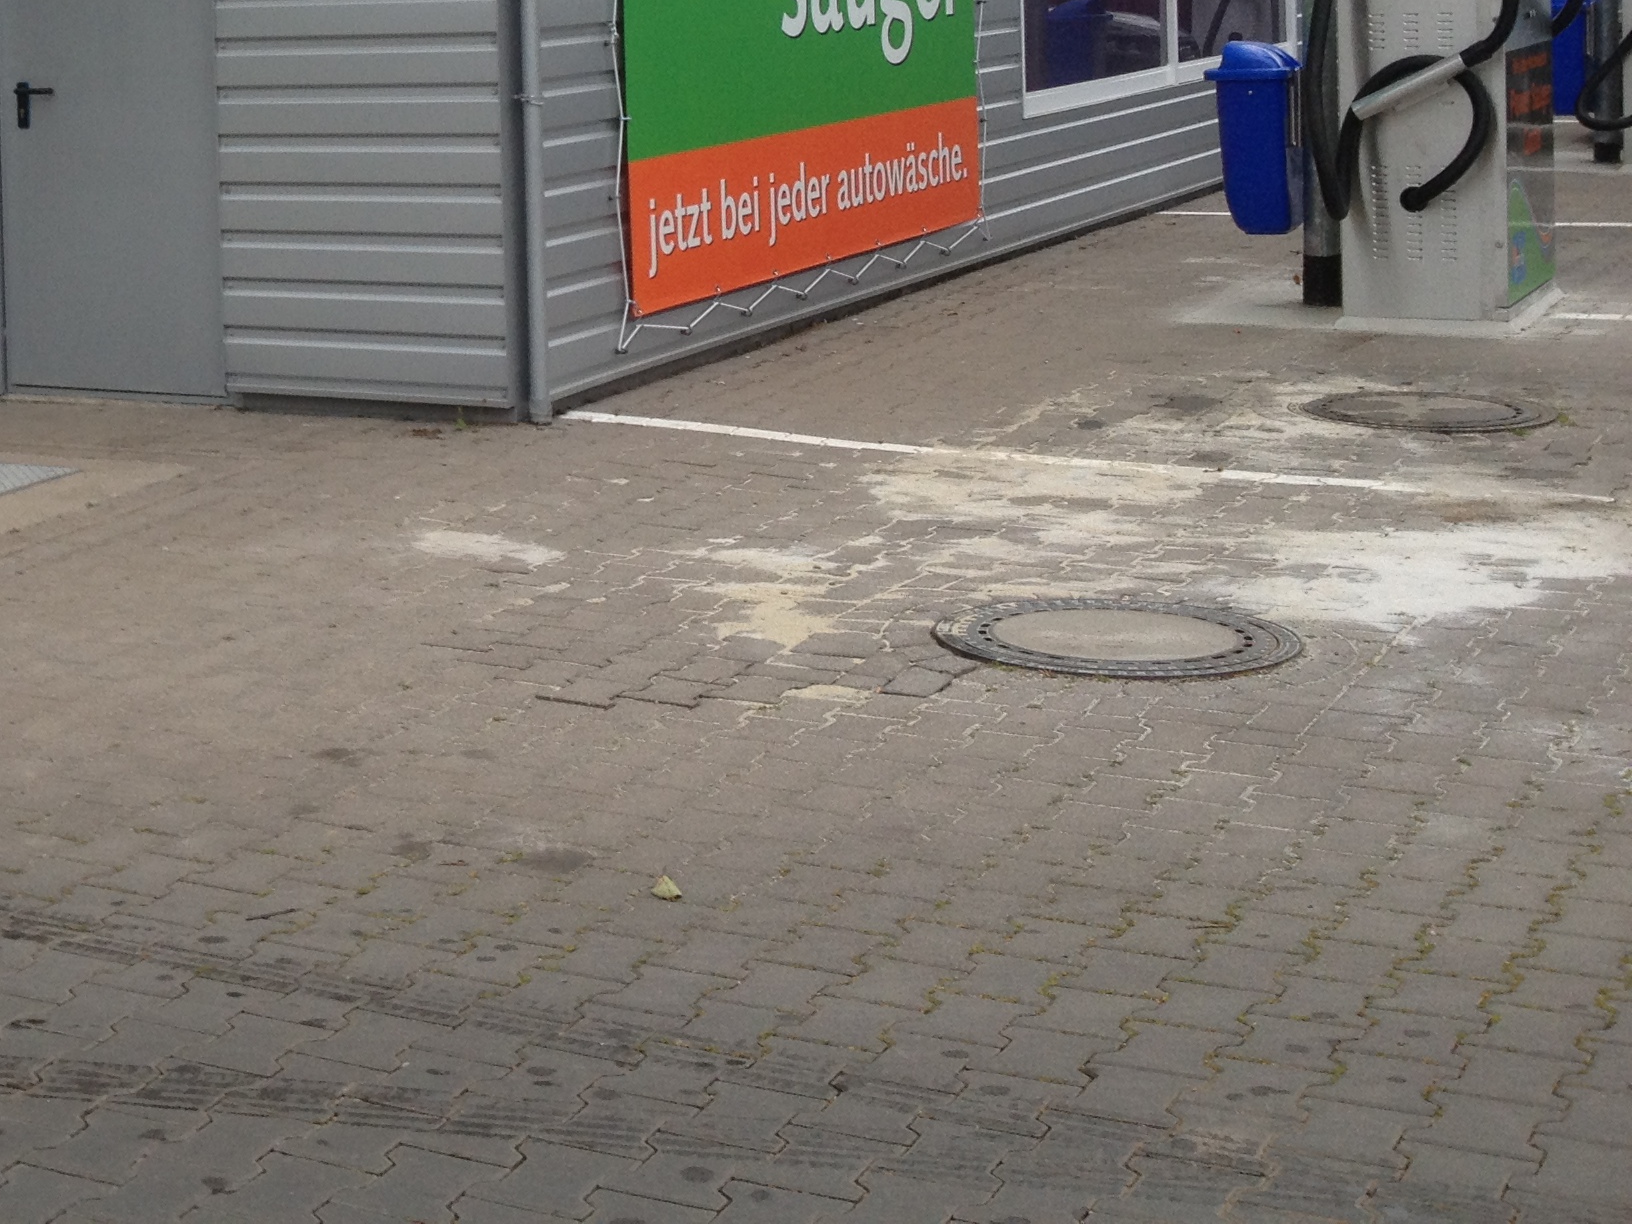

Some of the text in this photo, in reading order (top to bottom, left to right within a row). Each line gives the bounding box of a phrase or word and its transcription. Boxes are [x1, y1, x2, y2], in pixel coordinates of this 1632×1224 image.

[648, 131, 968, 278] jetzt bei jeder autowäsche.
